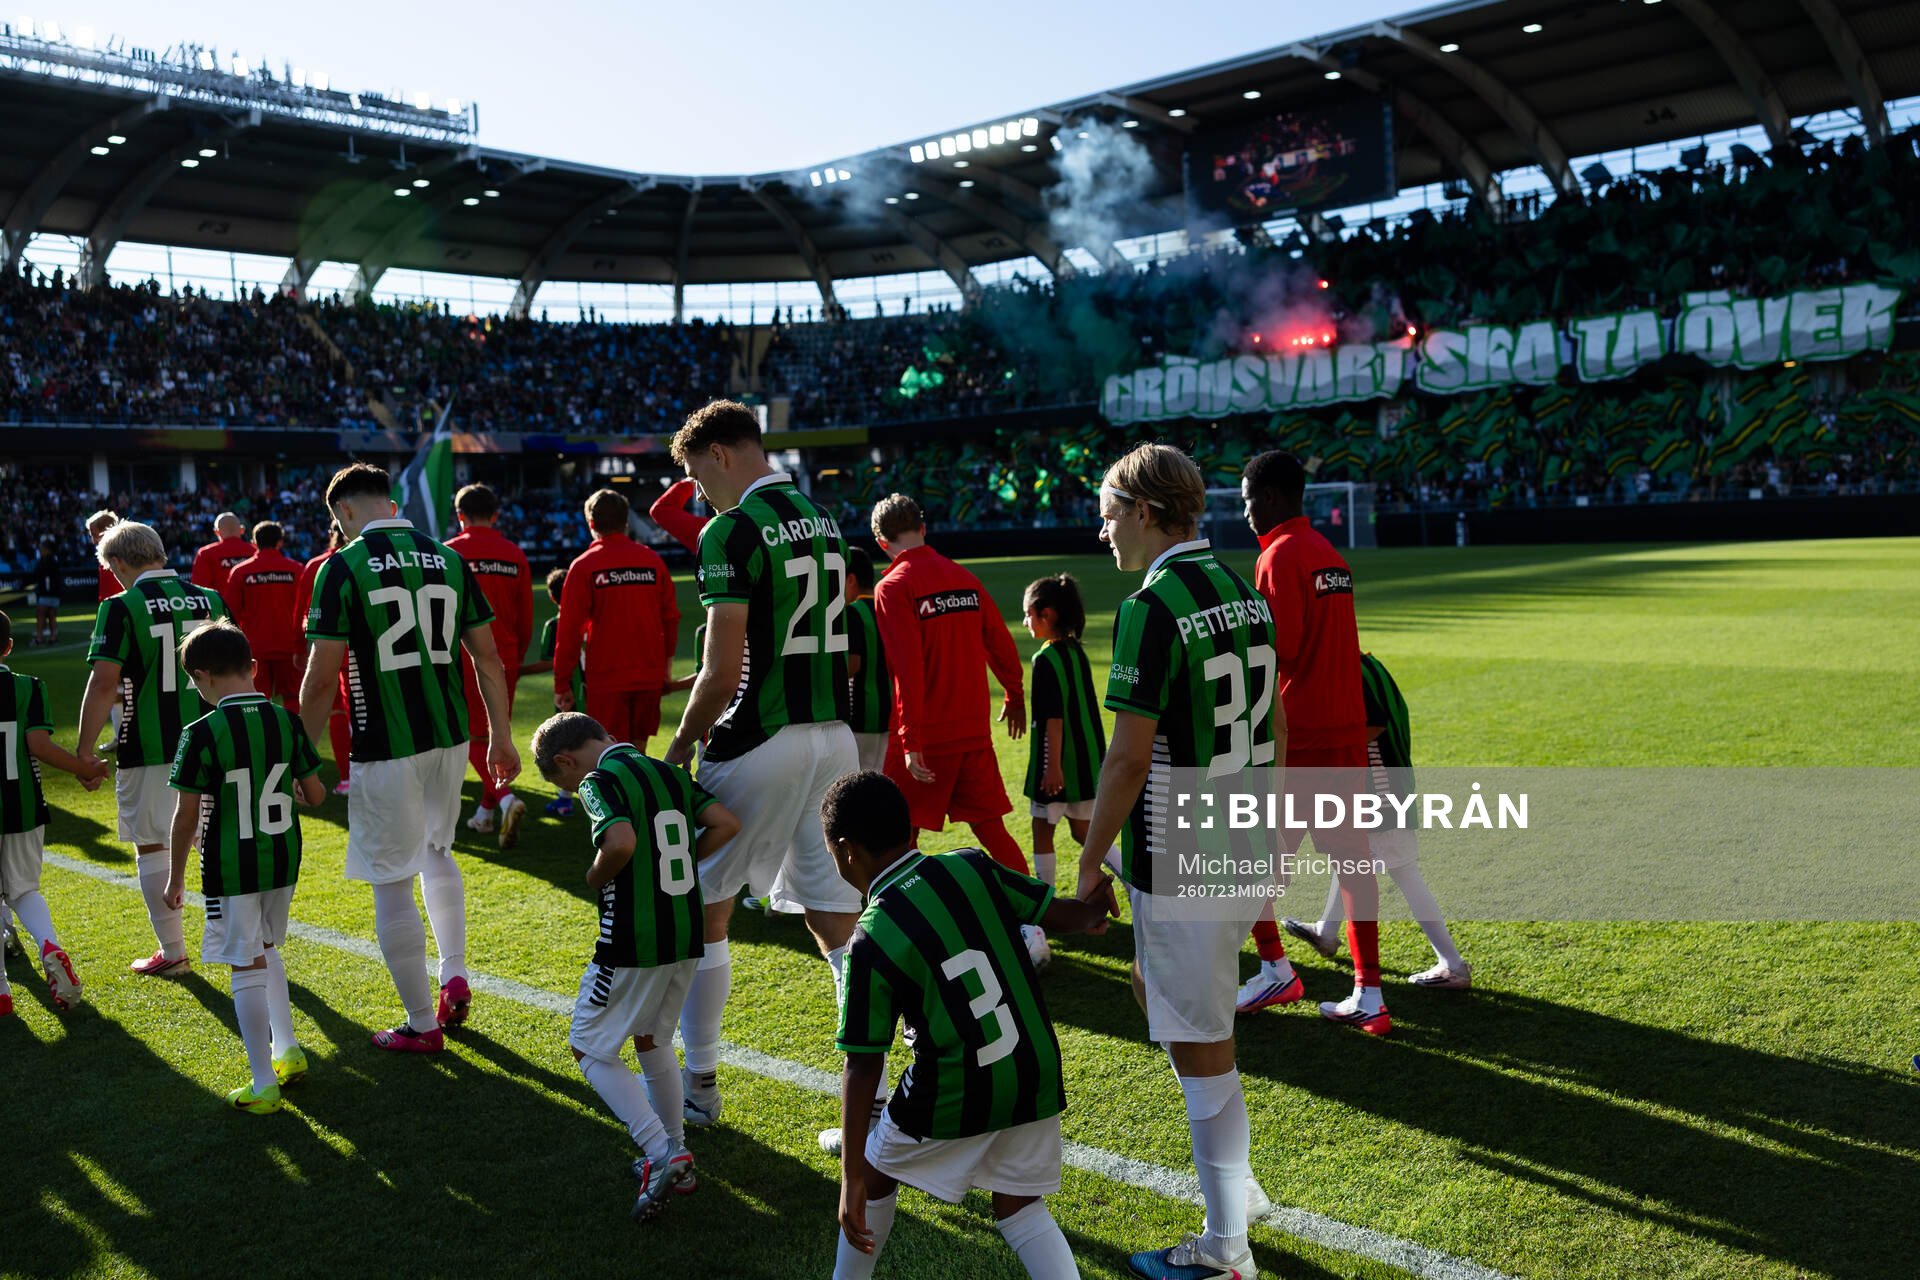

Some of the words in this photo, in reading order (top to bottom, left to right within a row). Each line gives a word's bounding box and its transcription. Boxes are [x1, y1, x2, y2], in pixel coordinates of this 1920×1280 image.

[1104, 341, 1404, 424] GRÖNSVART
[1422, 321, 1558, 389] SKA
[1576, 311, 1662, 380] TA
[1684, 286, 1900, 368] ÖVER
[367, 551, 448, 573] SALTER
[610, 570, 655, 584] Sydbank
[781, 552, 849, 656] 22
[145, 597, 211, 615] FROSTI
[368, 584, 458, 672] 20
[1203, 643, 1277, 780] 32
[225, 762, 293, 840] 16
[653, 809, 696, 896] 8
[899, 873, 921, 891] 1894
[941, 949, 1020, 1067] 3
